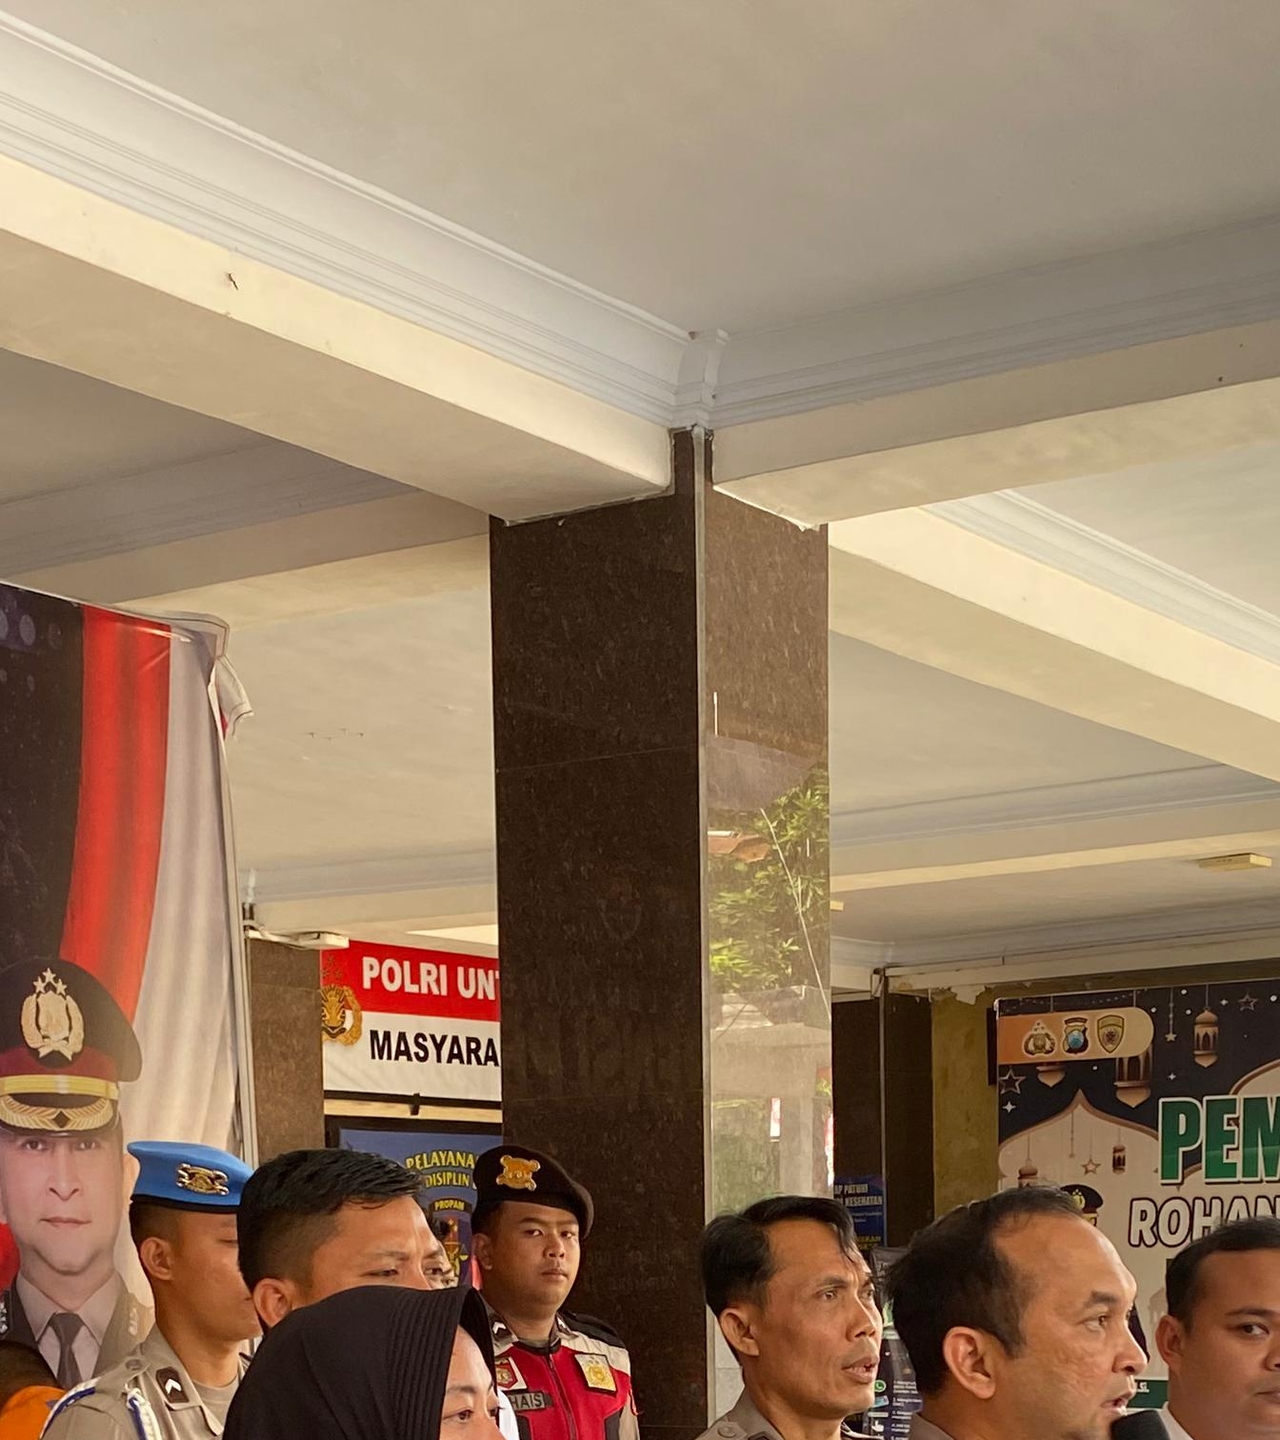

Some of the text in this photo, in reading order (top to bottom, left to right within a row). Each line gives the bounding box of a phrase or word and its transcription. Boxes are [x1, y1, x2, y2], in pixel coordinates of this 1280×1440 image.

[362, 956, 499, 1000] POLRI UN
[370, 1029, 499, 1067] MASYARA
[405, 1150, 479, 1170] PELAYANA
[425, 1171, 470, 1188] DISIPLIN
[434, 1200, 465, 1211] PROPAM
